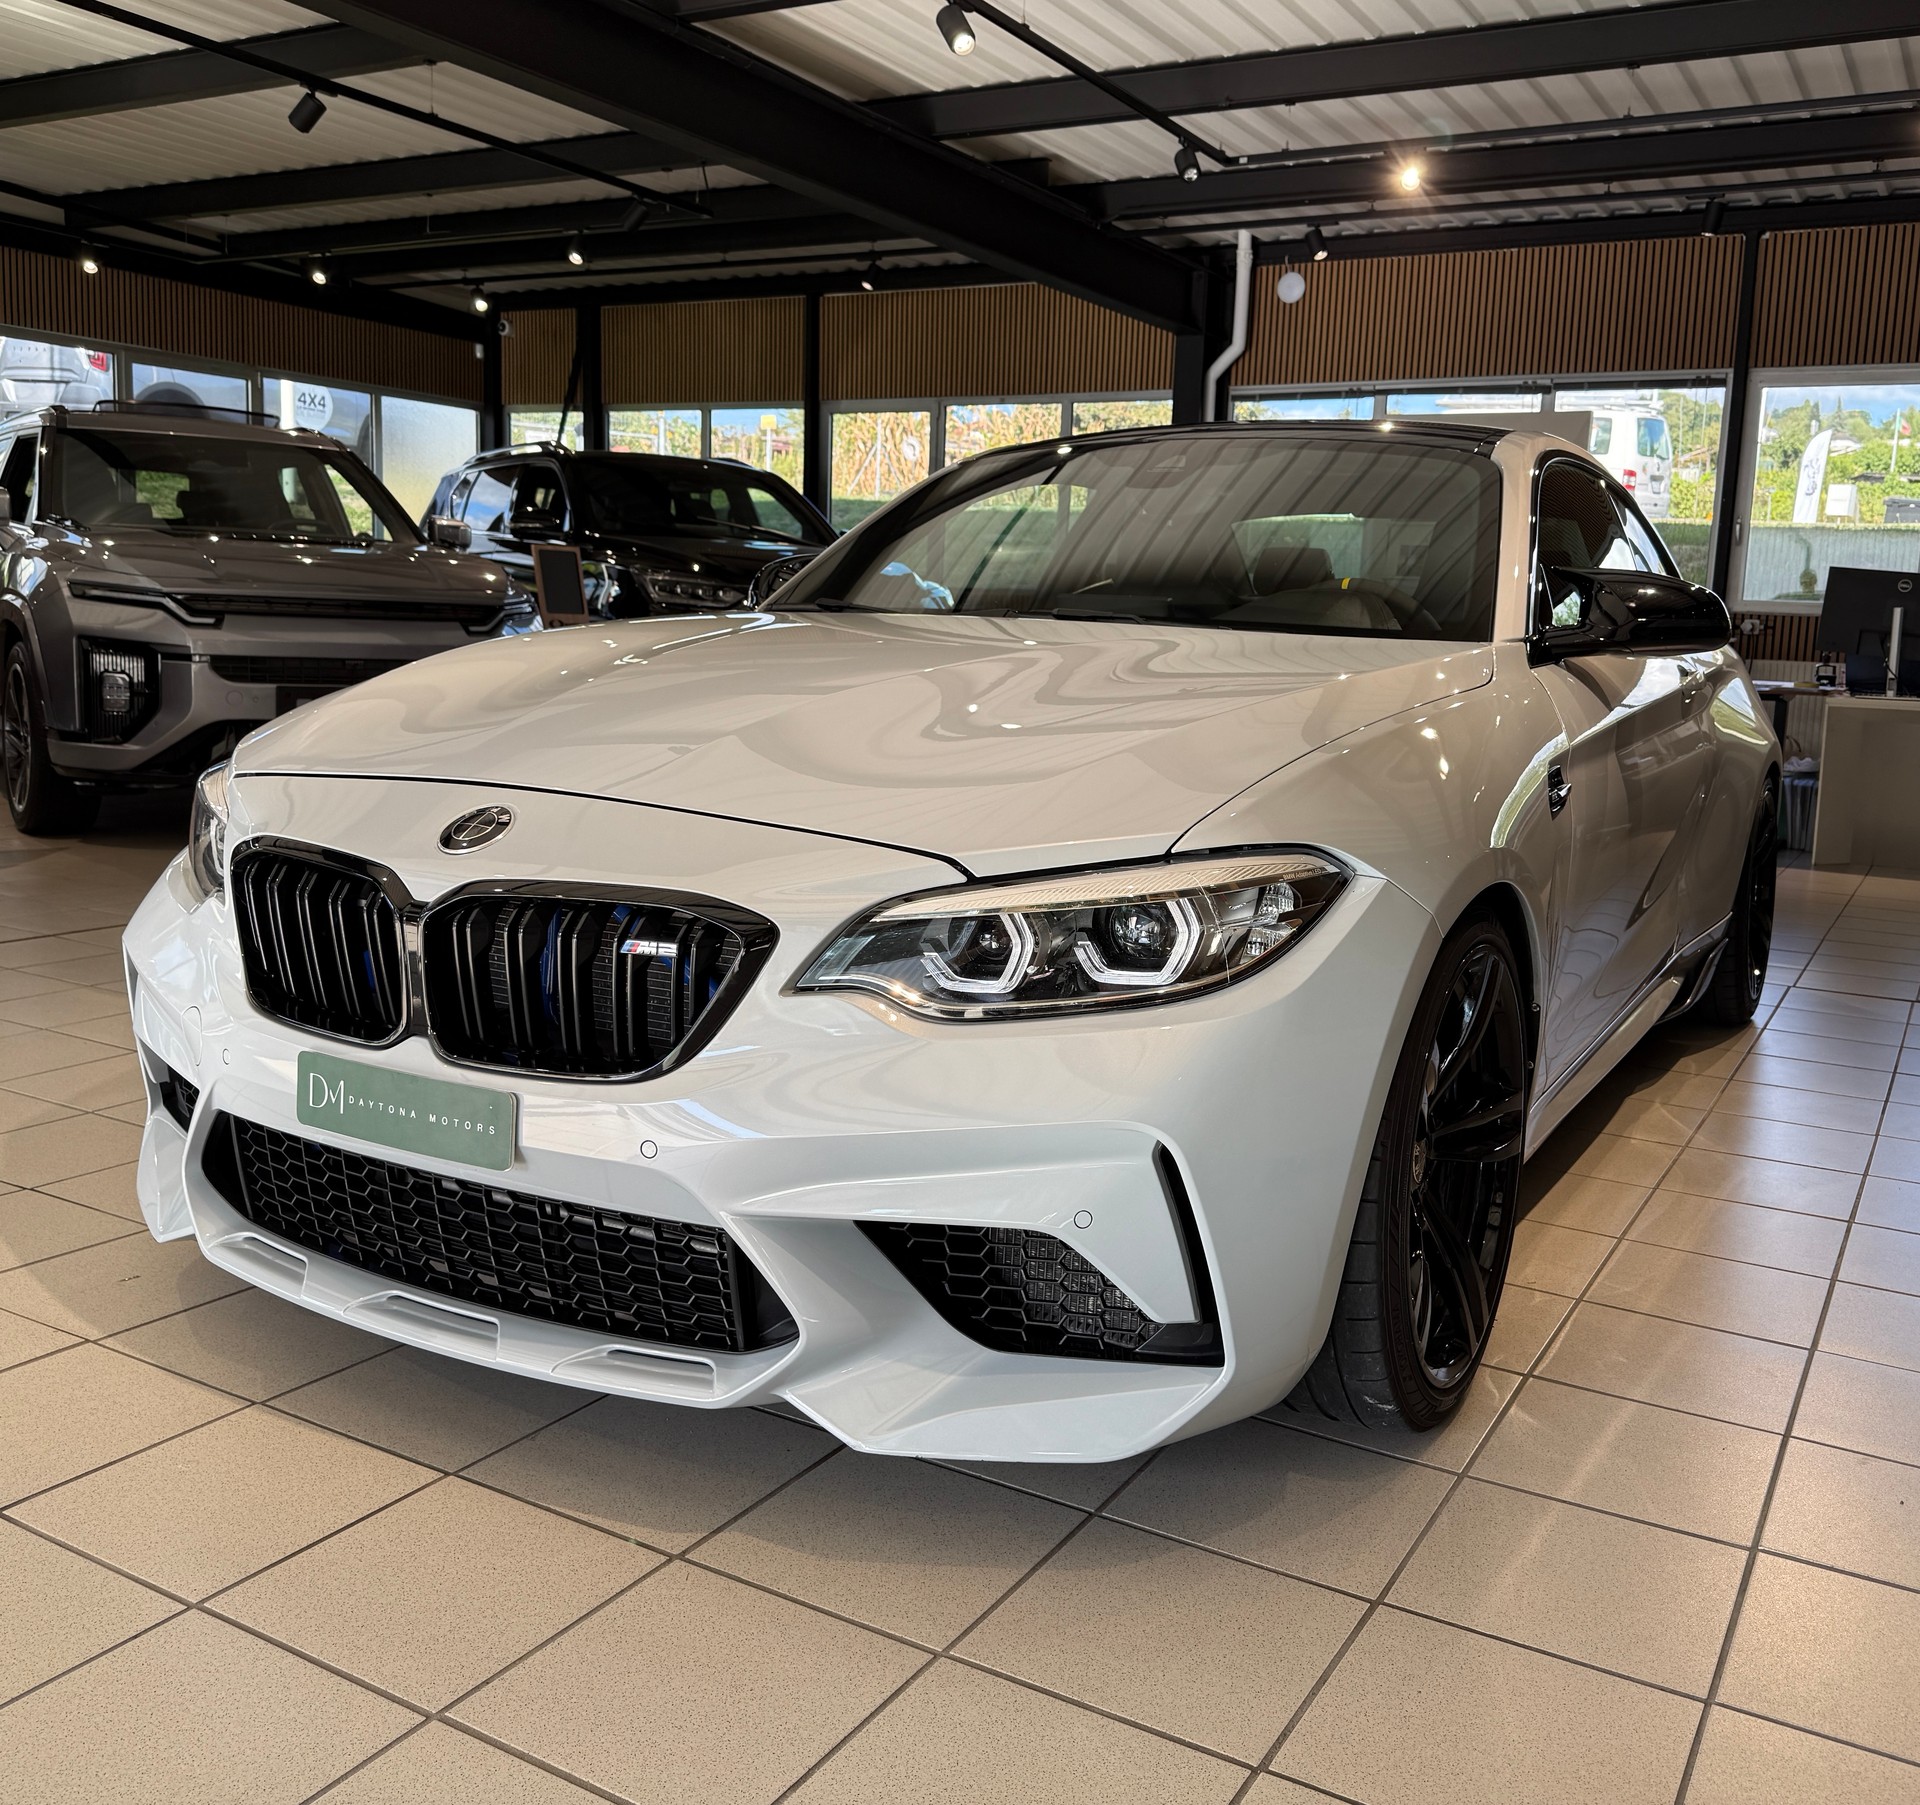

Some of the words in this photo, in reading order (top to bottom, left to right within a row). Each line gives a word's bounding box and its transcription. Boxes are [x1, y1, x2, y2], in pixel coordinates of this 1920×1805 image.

[298, 392, 326, 409] 4X4
[309, 1072, 345, 1115] DM
[348, 1095, 416, 1119] DAYTONA
[429, 1113, 495, 1135] MOTORS
